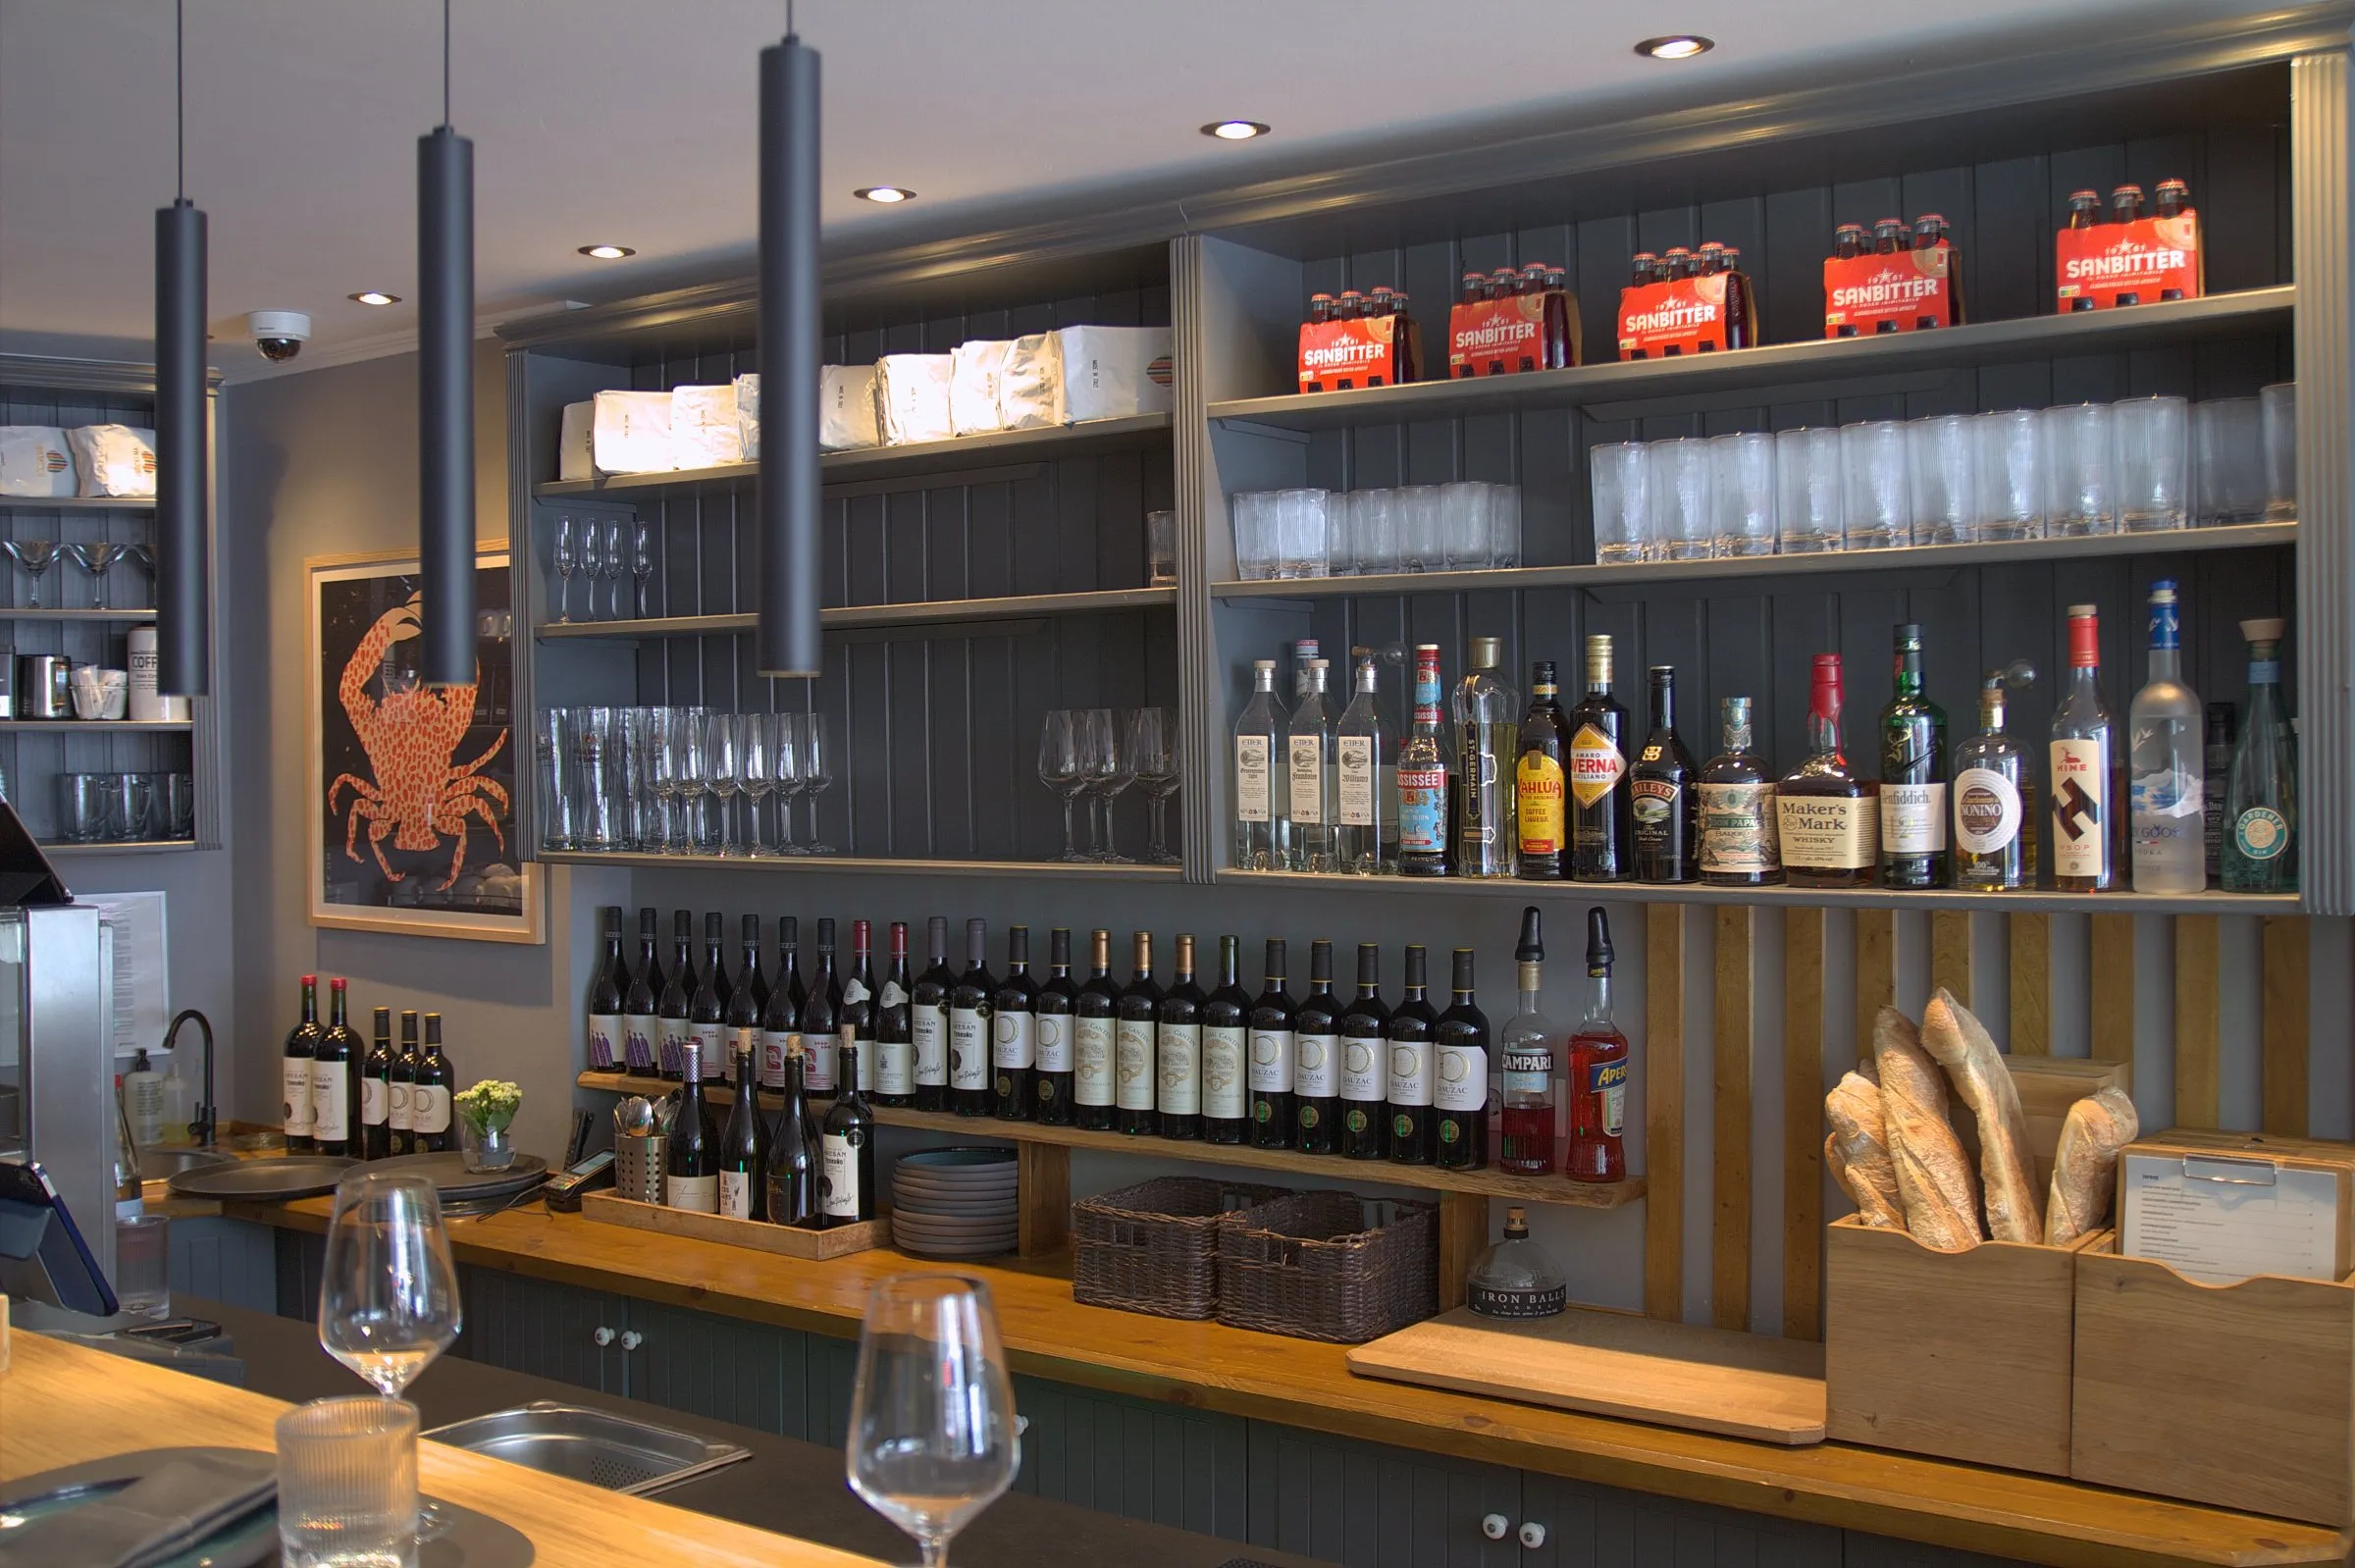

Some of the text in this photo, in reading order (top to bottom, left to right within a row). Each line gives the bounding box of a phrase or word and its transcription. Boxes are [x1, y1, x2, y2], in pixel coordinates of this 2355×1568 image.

[132, 656, 157, 668] COFF
[2057, 763, 2087, 772] HINE
[1633, 783, 1673, 797] AILEYS
[1782, 802, 1847, 815] Maker's
[1501, 1054, 1551, 1071] CAMPARI
[1597, 1066, 1626, 1086] APER
[1389, 1080, 1420, 1089] DAUZAC
[1437, 1084, 1468, 1094] DAUZAC
[1482, 1288, 1564, 1304] IRON BALLS
